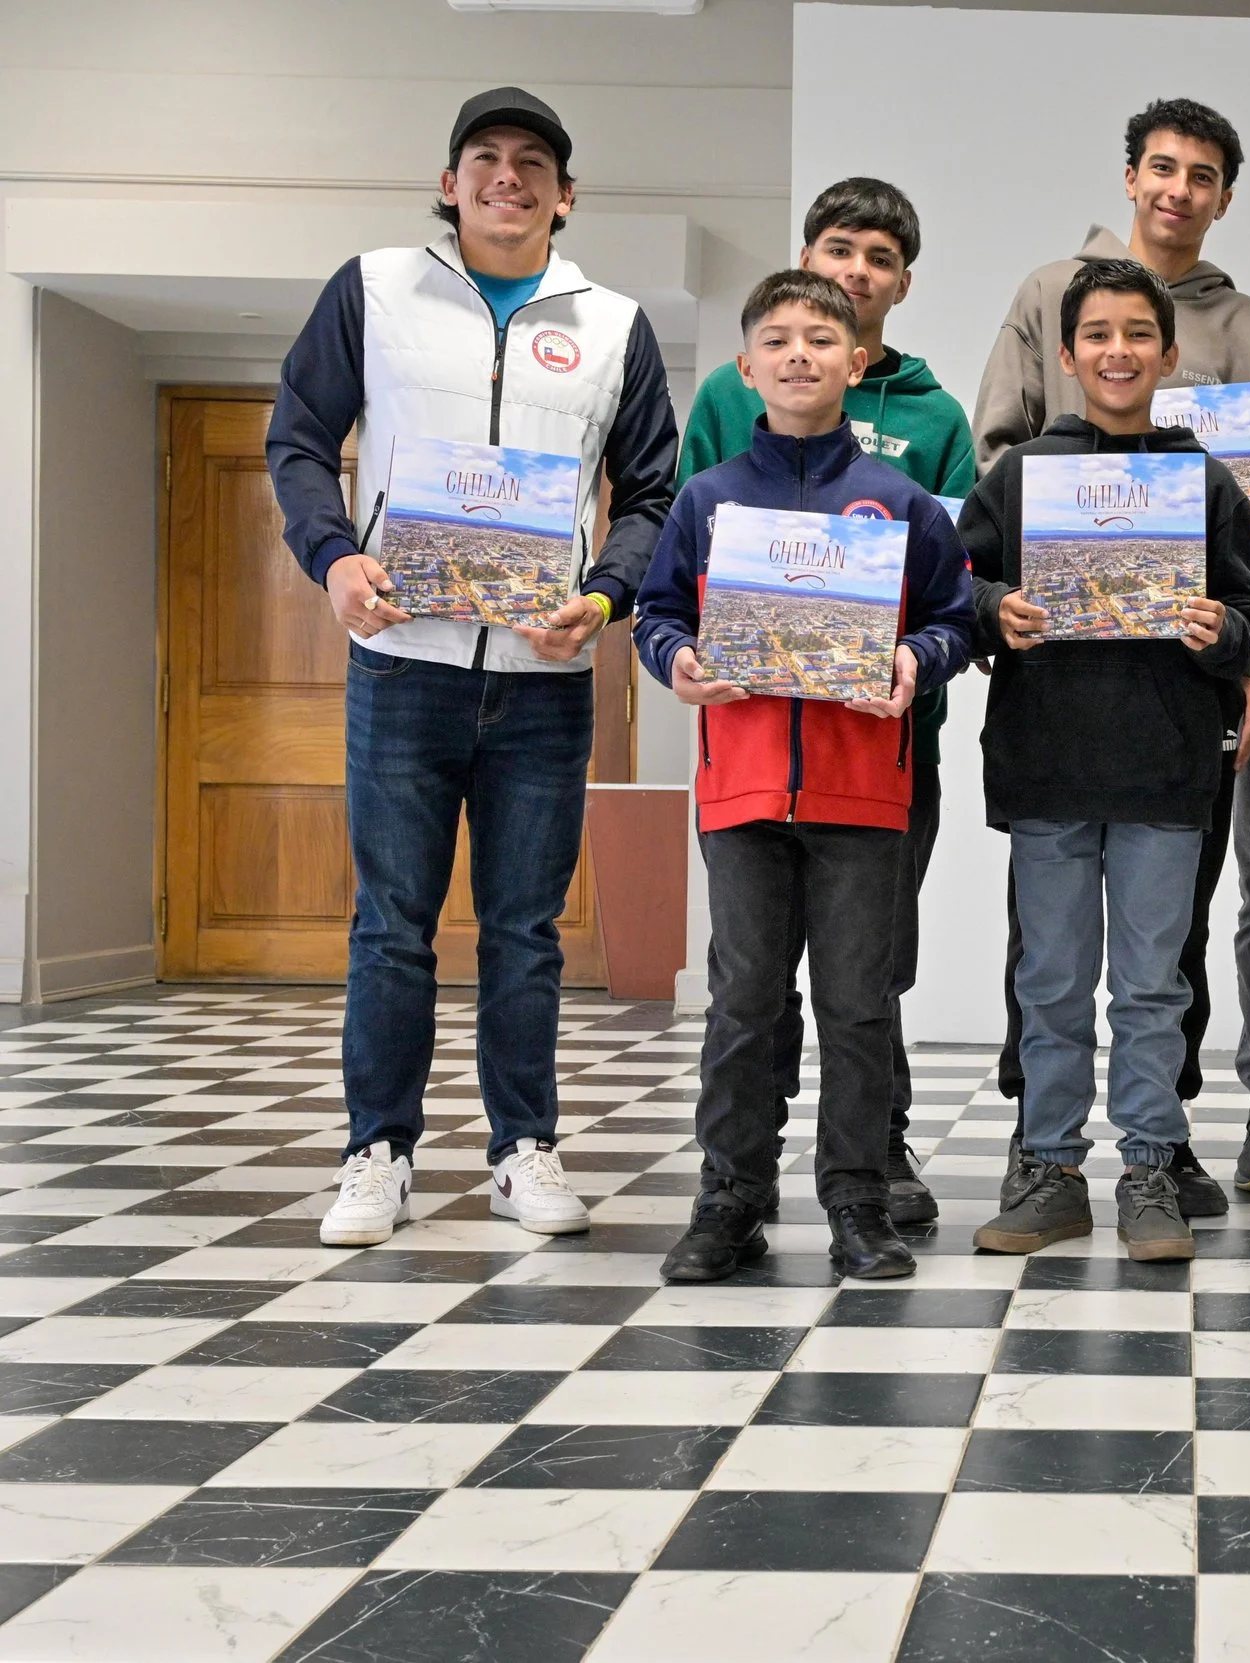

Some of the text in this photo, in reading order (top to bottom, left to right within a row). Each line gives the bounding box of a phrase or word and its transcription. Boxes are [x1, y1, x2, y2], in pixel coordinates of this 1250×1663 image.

[446, 470, 521, 501] CHILLÁN
[1077, 479, 1149, 509] CHILLÁN
[769, 539, 847, 569] CHILLÁN
